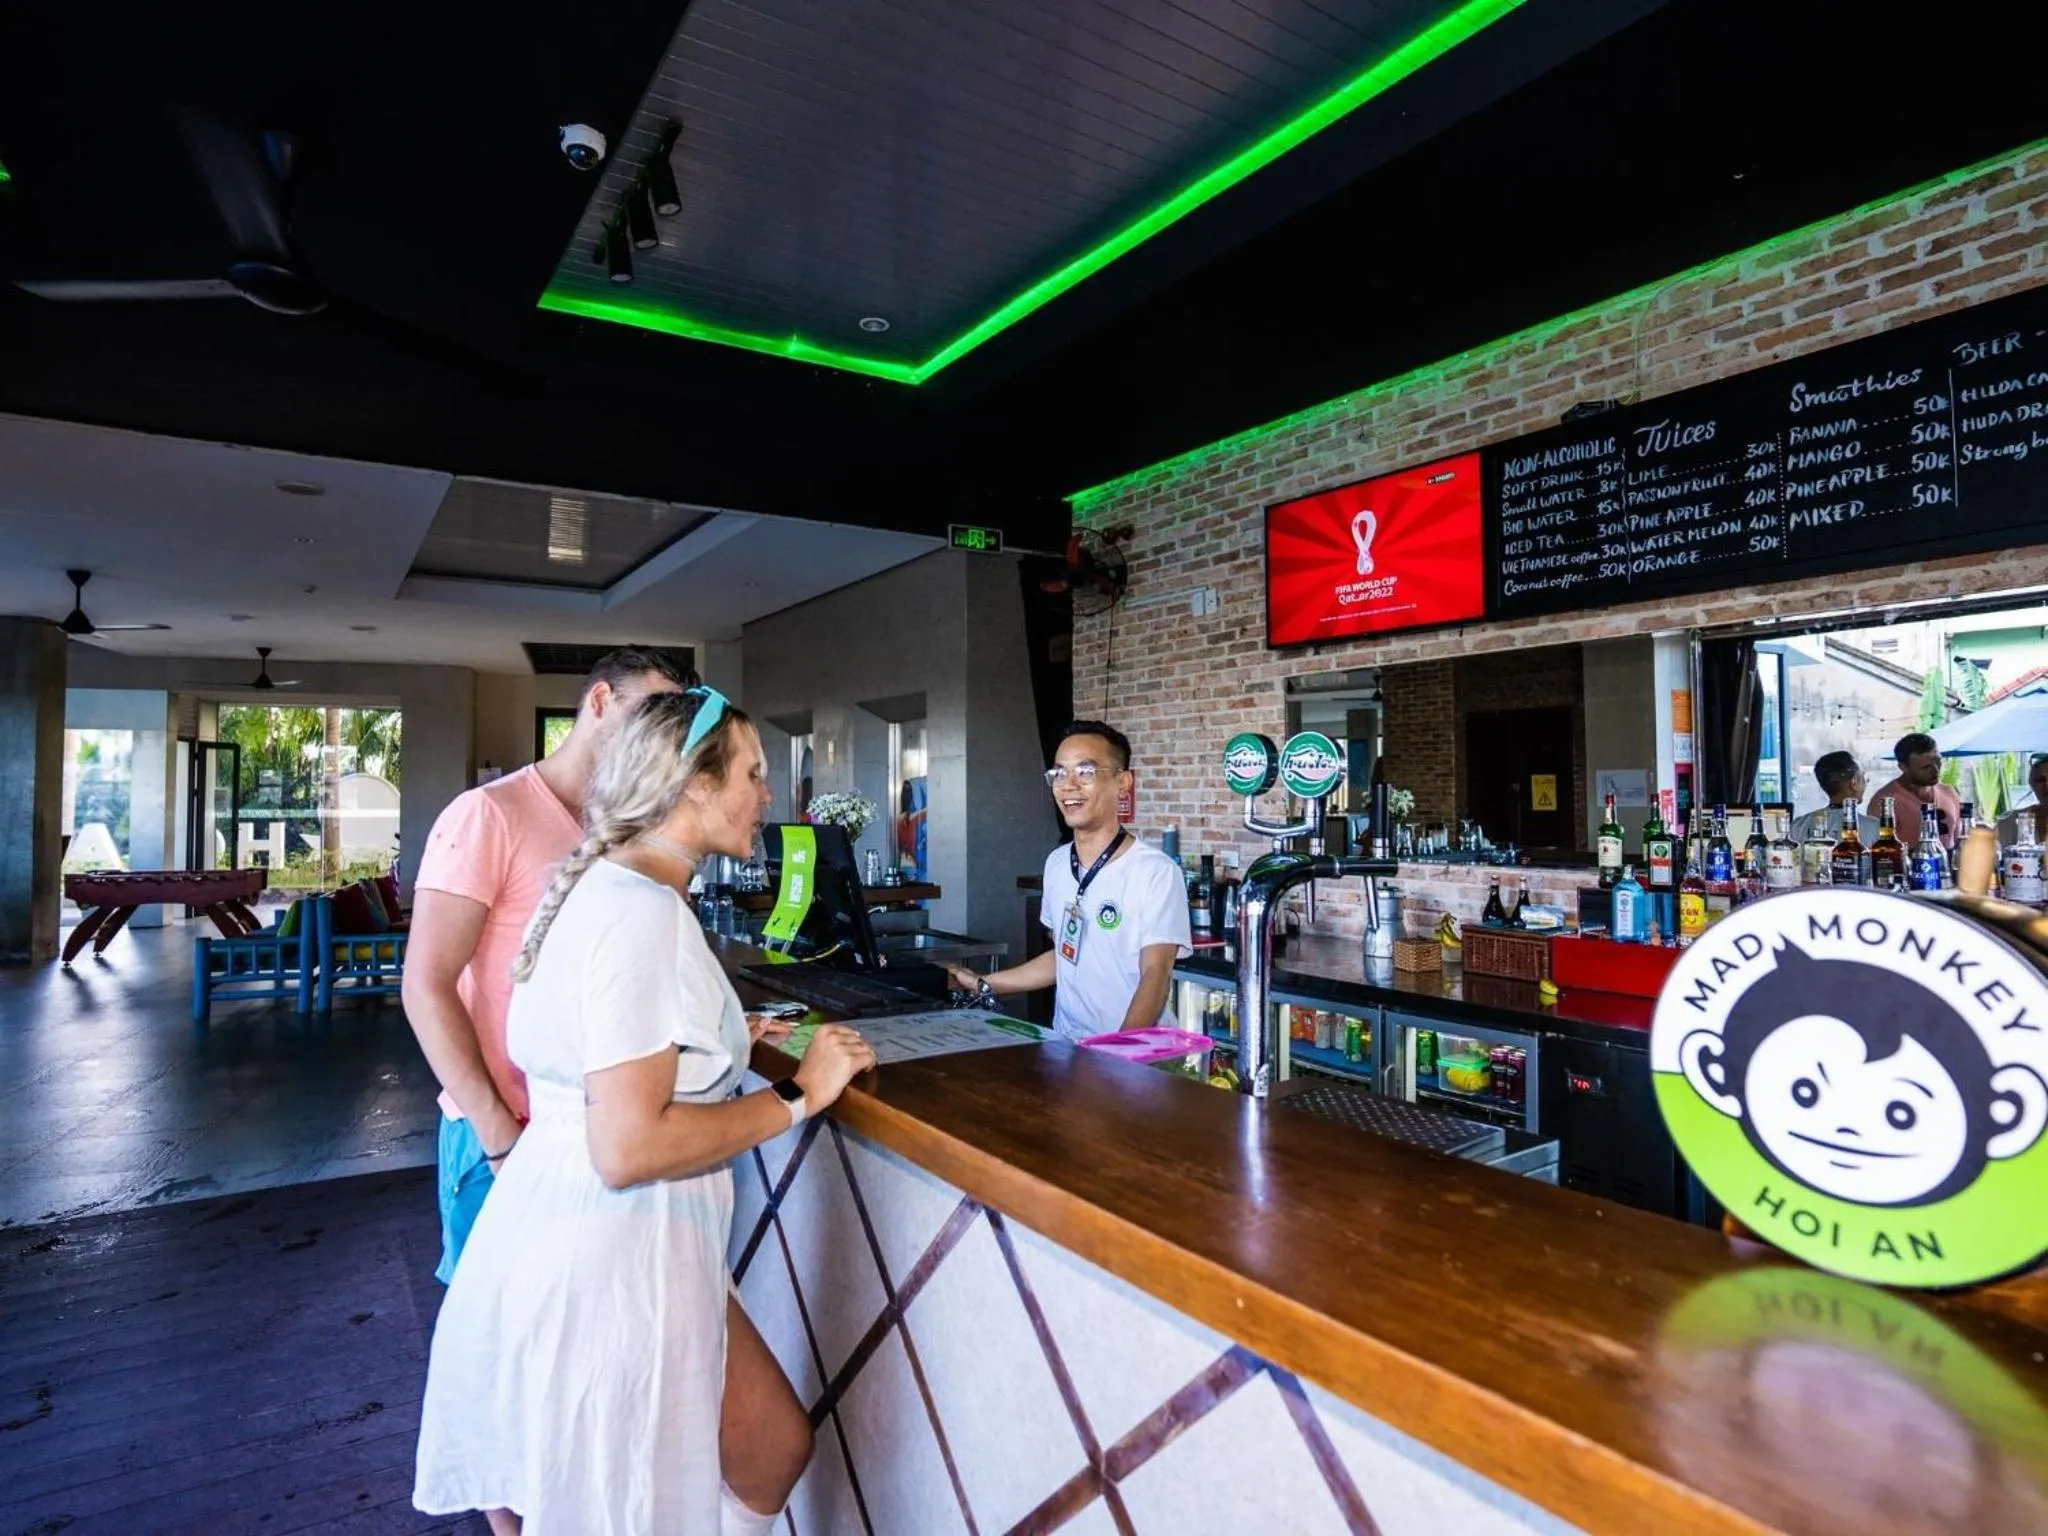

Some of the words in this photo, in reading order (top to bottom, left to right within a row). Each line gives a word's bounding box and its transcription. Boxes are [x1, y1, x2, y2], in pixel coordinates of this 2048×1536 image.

[1952, 331, 2024, 366] BEER
[1789, 367, 1923, 412] Smoothies
[1789, 417, 1859, 446] BANANA
[1961, 409, 2014, 433] HUDA
[1503, 436, 1616, 480] NON-ALCOHOLIC
[1787, 440, 1861, 472] MANGO
[1960, 441, 2029, 465] Strong
[1502, 480, 1538, 499] SOFT
[1541, 471, 1584, 489] DRINK
[1628, 465, 1669, 486] LIME
[1502, 497, 1536, 517] Small
[1540, 488, 1587, 508] WATER
[1789, 500, 1864, 532] MIXED
[1527, 510, 1577, 531] WATER
[1504, 540, 1533, 555] ICED
[1536, 533, 1565, 550] TEA
[1631, 531, 1686, 554] WATER
[1688, 519, 1742, 541] MELON
[1632, 550, 1701, 573] ORANGE
[1335, 584, 1352, 595] FIFA
[1352, 579, 1381, 592] WORLD
[1381, 575, 1398, 587] CUP
[1683, 932, 1764, 1012] MAD
[1807, 914, 2042, 1036] MONKEY
[1753, 1184, 1841, 1248] HOI
[1870, 1231, 1946, 1261] AN
